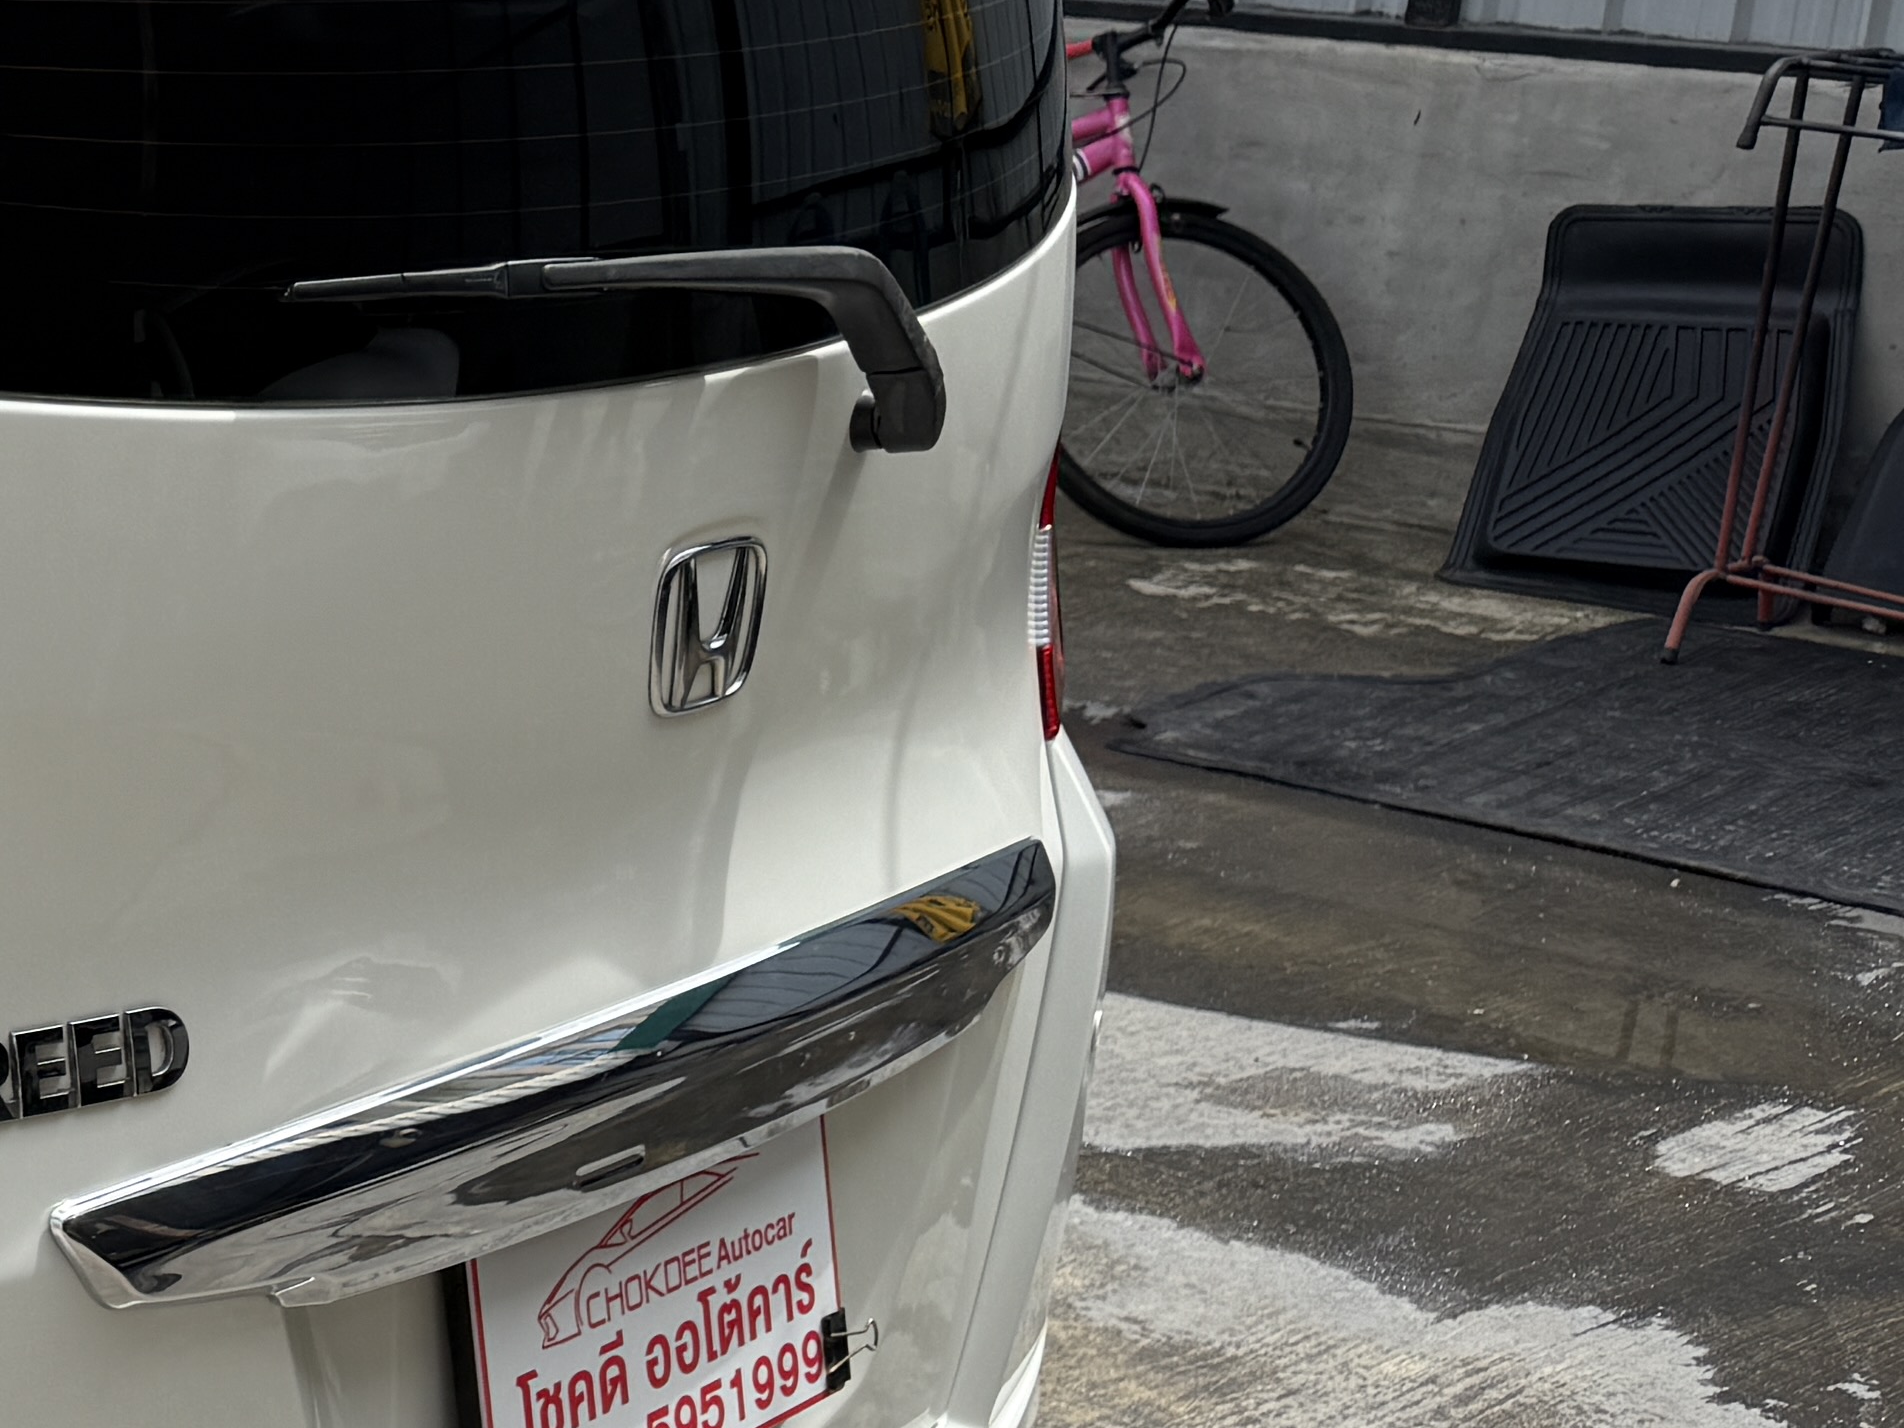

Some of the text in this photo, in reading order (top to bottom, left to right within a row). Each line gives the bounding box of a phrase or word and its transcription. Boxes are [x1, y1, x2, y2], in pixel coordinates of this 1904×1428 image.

[586, 1211, 797, 1329] CHOKDEE Autocar
[645, 1237, 817, 1389] ออโต้คาร์
